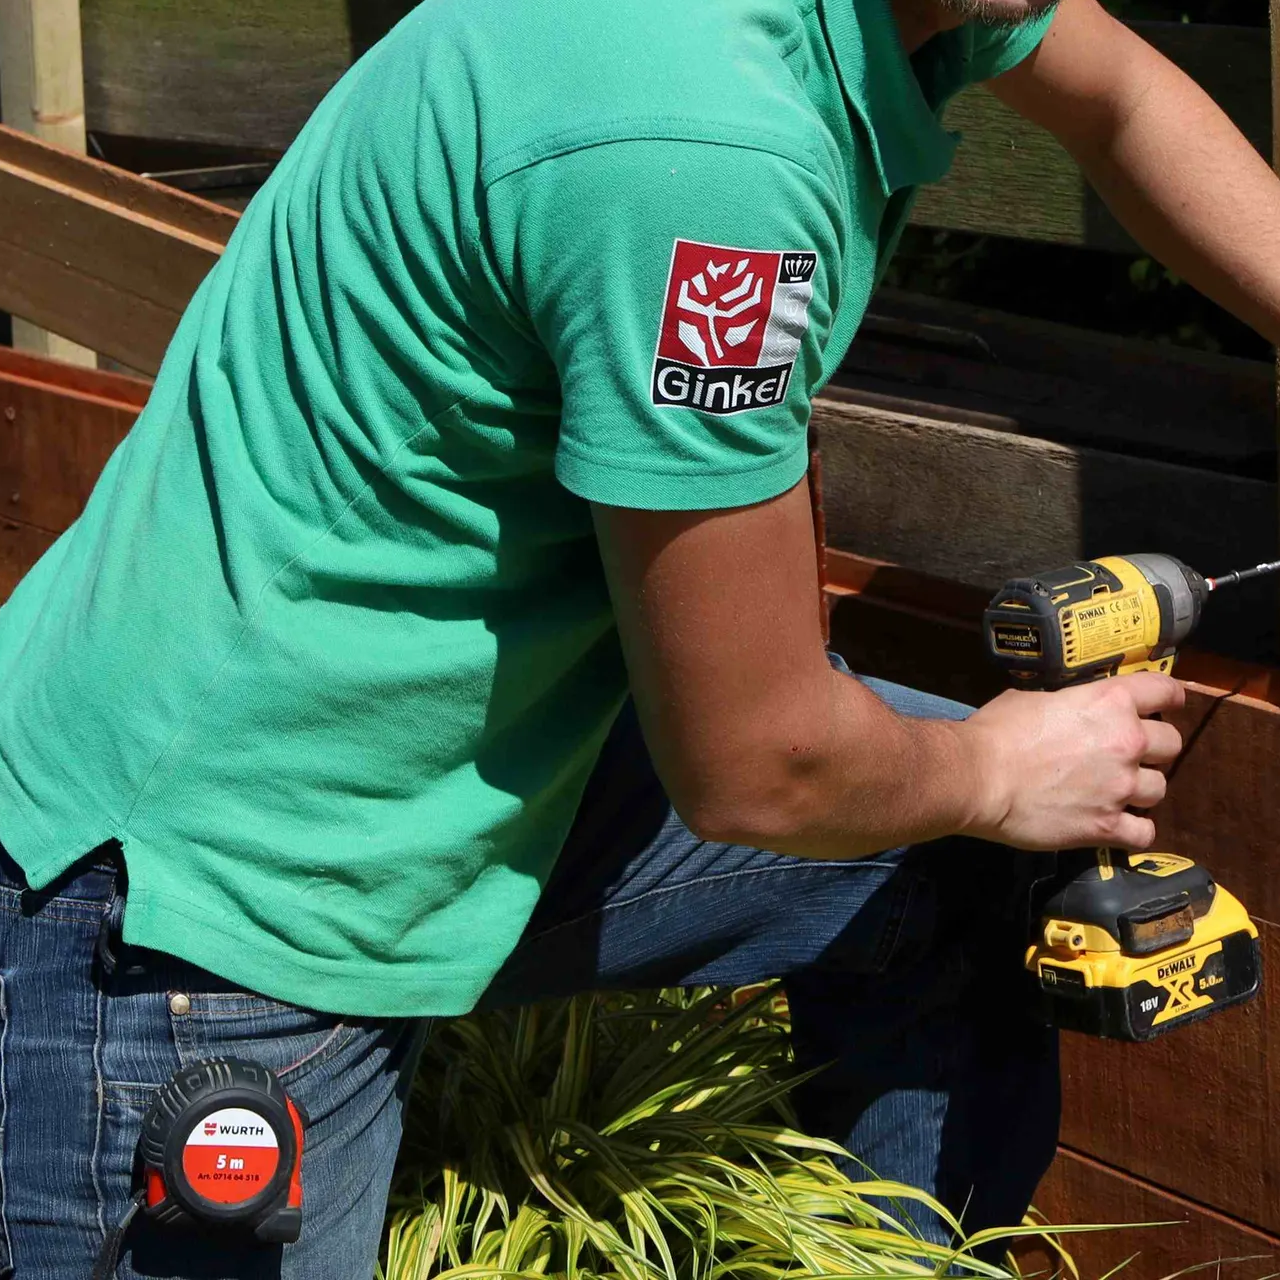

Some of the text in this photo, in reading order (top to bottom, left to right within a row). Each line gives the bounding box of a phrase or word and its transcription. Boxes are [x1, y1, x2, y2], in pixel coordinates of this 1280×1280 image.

[657, 366, 788, 410] Ginkel
[1140, 996, 1159, 1013] 18V
[216, 1154, 244, 1170] 5 m
